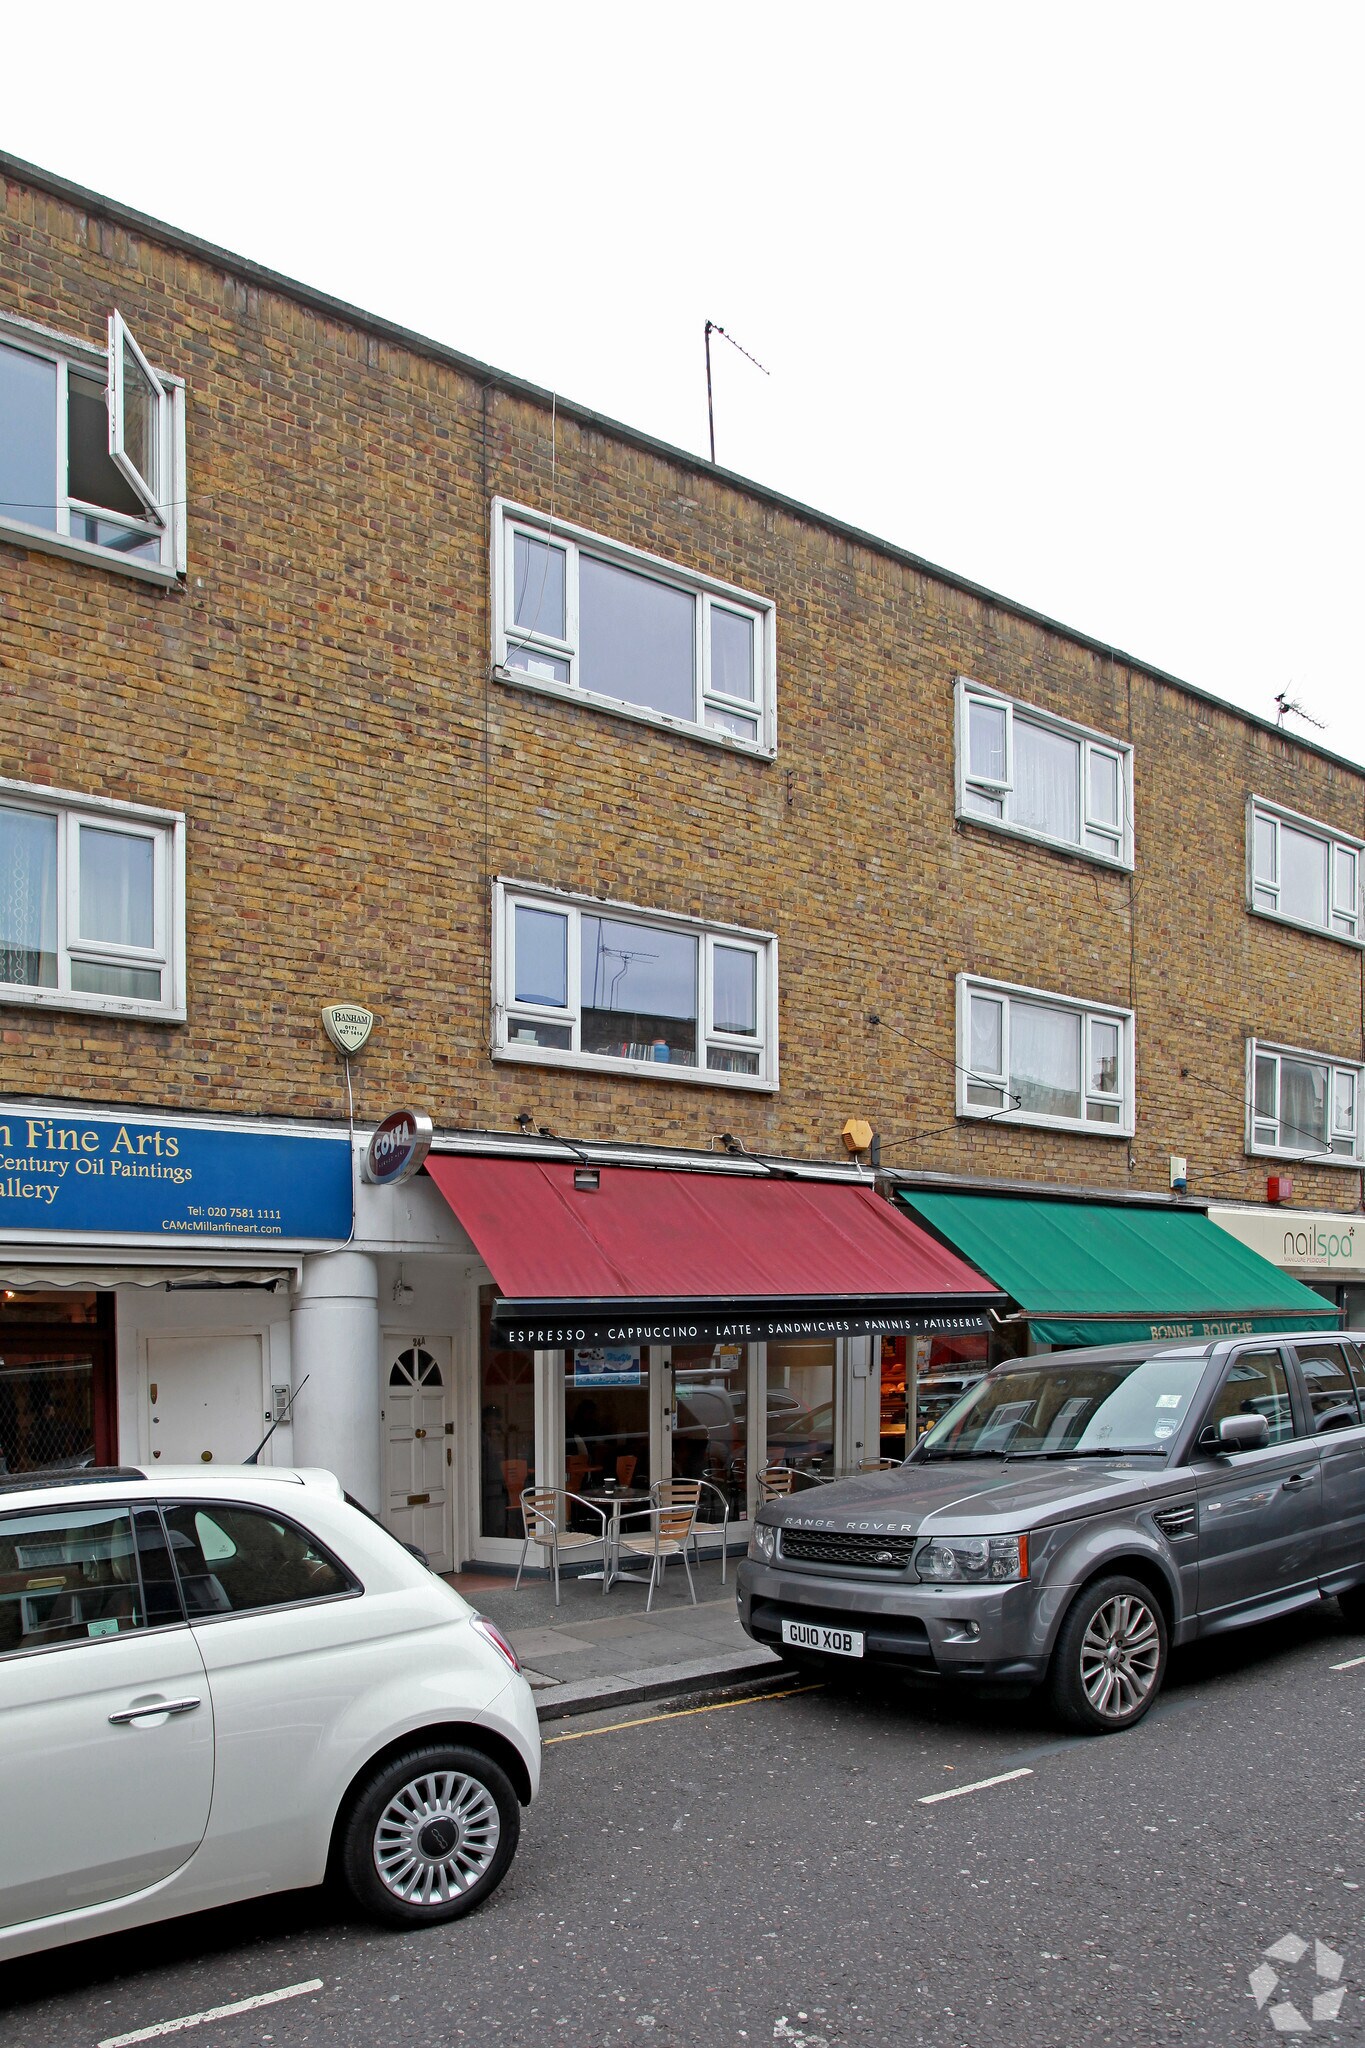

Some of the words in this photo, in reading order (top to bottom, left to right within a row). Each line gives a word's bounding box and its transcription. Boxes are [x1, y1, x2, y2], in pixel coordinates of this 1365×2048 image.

[335, 1012, 367, 1023] BANHAM
[26, 1119, 99, 1151] Fine
[110, 1126, 180, 1157] Arts
[374, 1120, 410, 1160] COSTA
[75, 1157, 105, 1176] Oil
[110, 1160, 193, 1184] Paintings
[187, 1206, 205, 1216] Tel:
[207, 1207, 228, 1217] 020
[229, 1208, 255, 1219] 7581
[257, 1209, 281, 1220] 1111
[161, 1220, 282, 1234] CAMcMillanfineart.com
[1283, 1223, 1353, 1267] nailspa
[509, 1329, 586, 1342] ESPRESSO
[607, 1326, 698, 1339] CAPPUCCINO
[715, 1324, 752, 1336] LATTE
[768, 1321, 850, 1334] SANDWICHES
[865, 1320, 911, 1329] PANINIS
[924, 1317, 983, 1328] PATISSERIE
[1150, 1324, 1194, 1341] BONNE
[1202, 1321, 1254, 1336] BOUCHE
[784, 1517, 835, 1528] RANGE
[846, 1522, 912, 1532] ROVER
[822, 1630, 852, 1652] XOB
